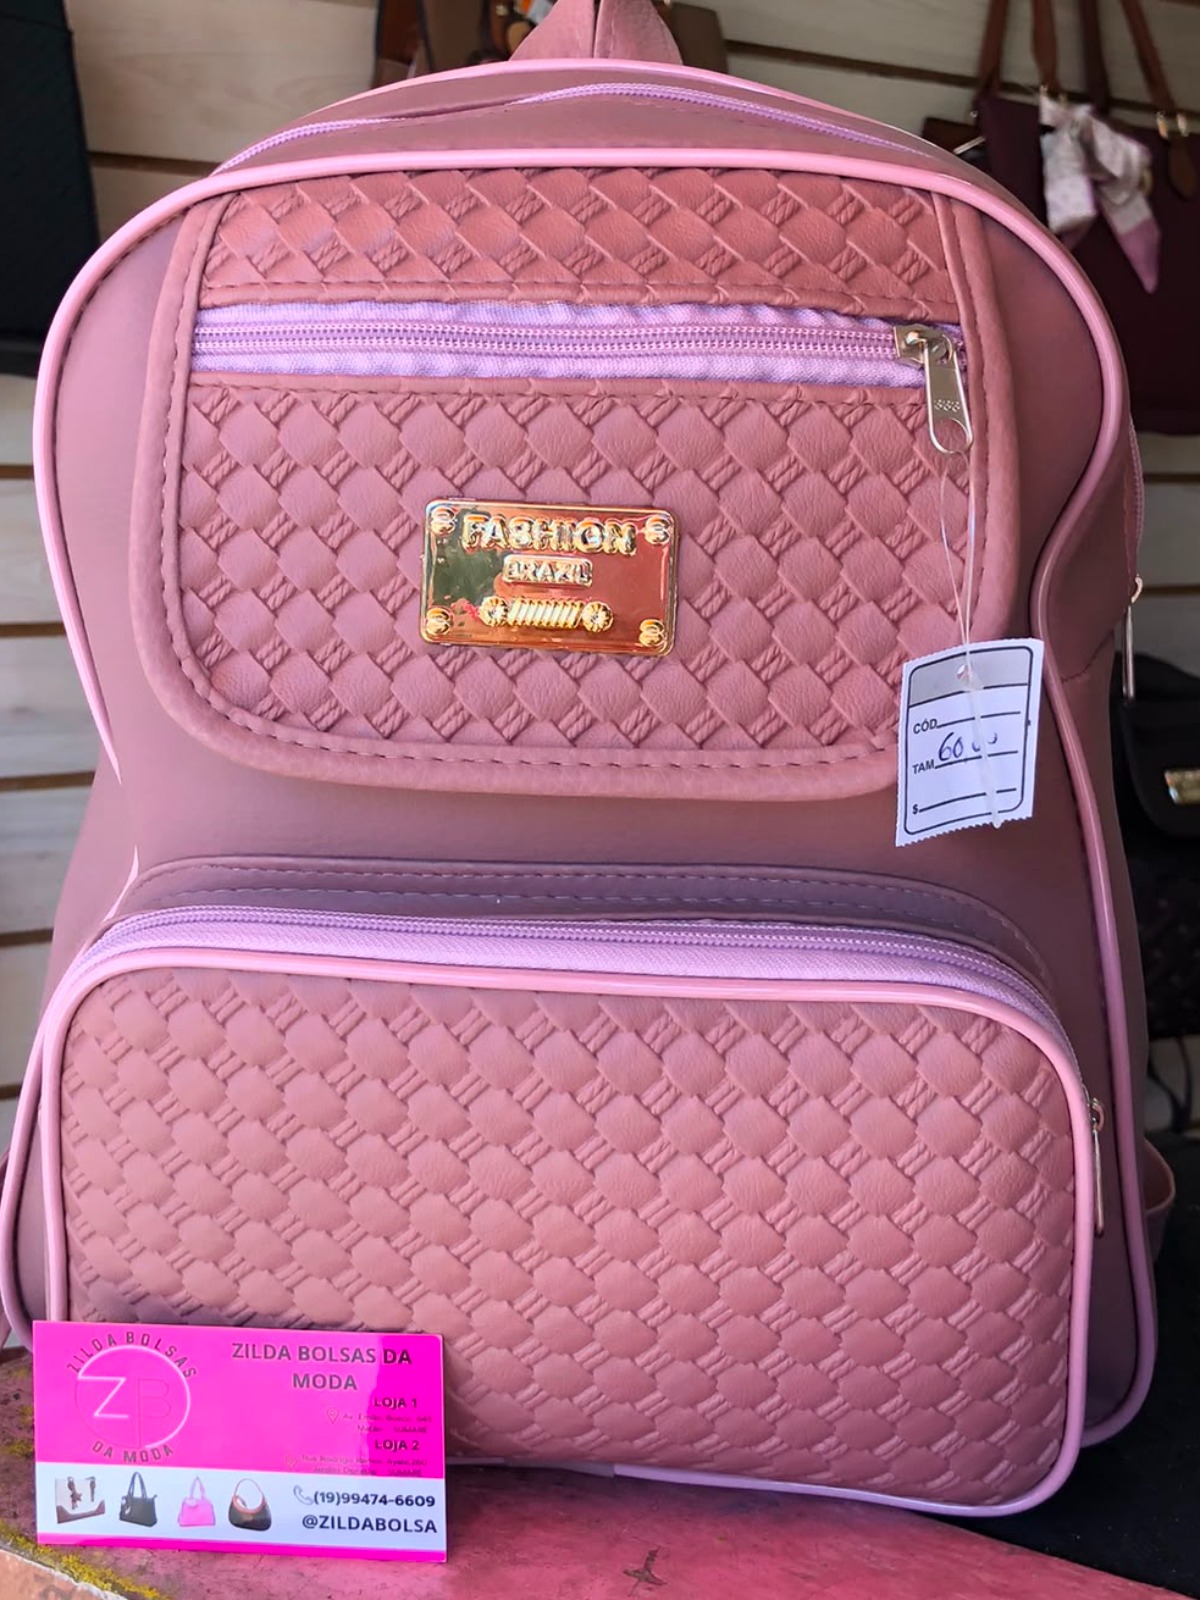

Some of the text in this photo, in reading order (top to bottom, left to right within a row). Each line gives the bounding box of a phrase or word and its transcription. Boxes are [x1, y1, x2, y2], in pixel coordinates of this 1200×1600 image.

[461, 514, 637, 555] FASHION
[505, 559, 592, 584] BRAZIL
[912, 759, 935, 774] TAM
[66, 1331, 197, 1380] ZILDA BOLSAS
[231, 1343, 412, 1365] ZILDA BOLSAS DA
[292, 1374, 357, 1390] MODA
[374, 1397, 417, 1410] LOJA 1
[92, 1440, 174, 1463] DA MODA
[375, 1439, 419, 1452] LOJA 2
[313, 1490, 436, 1507] (19)99474-6609
[302, 1515, 437, 1533] @ZILDABOLSA
